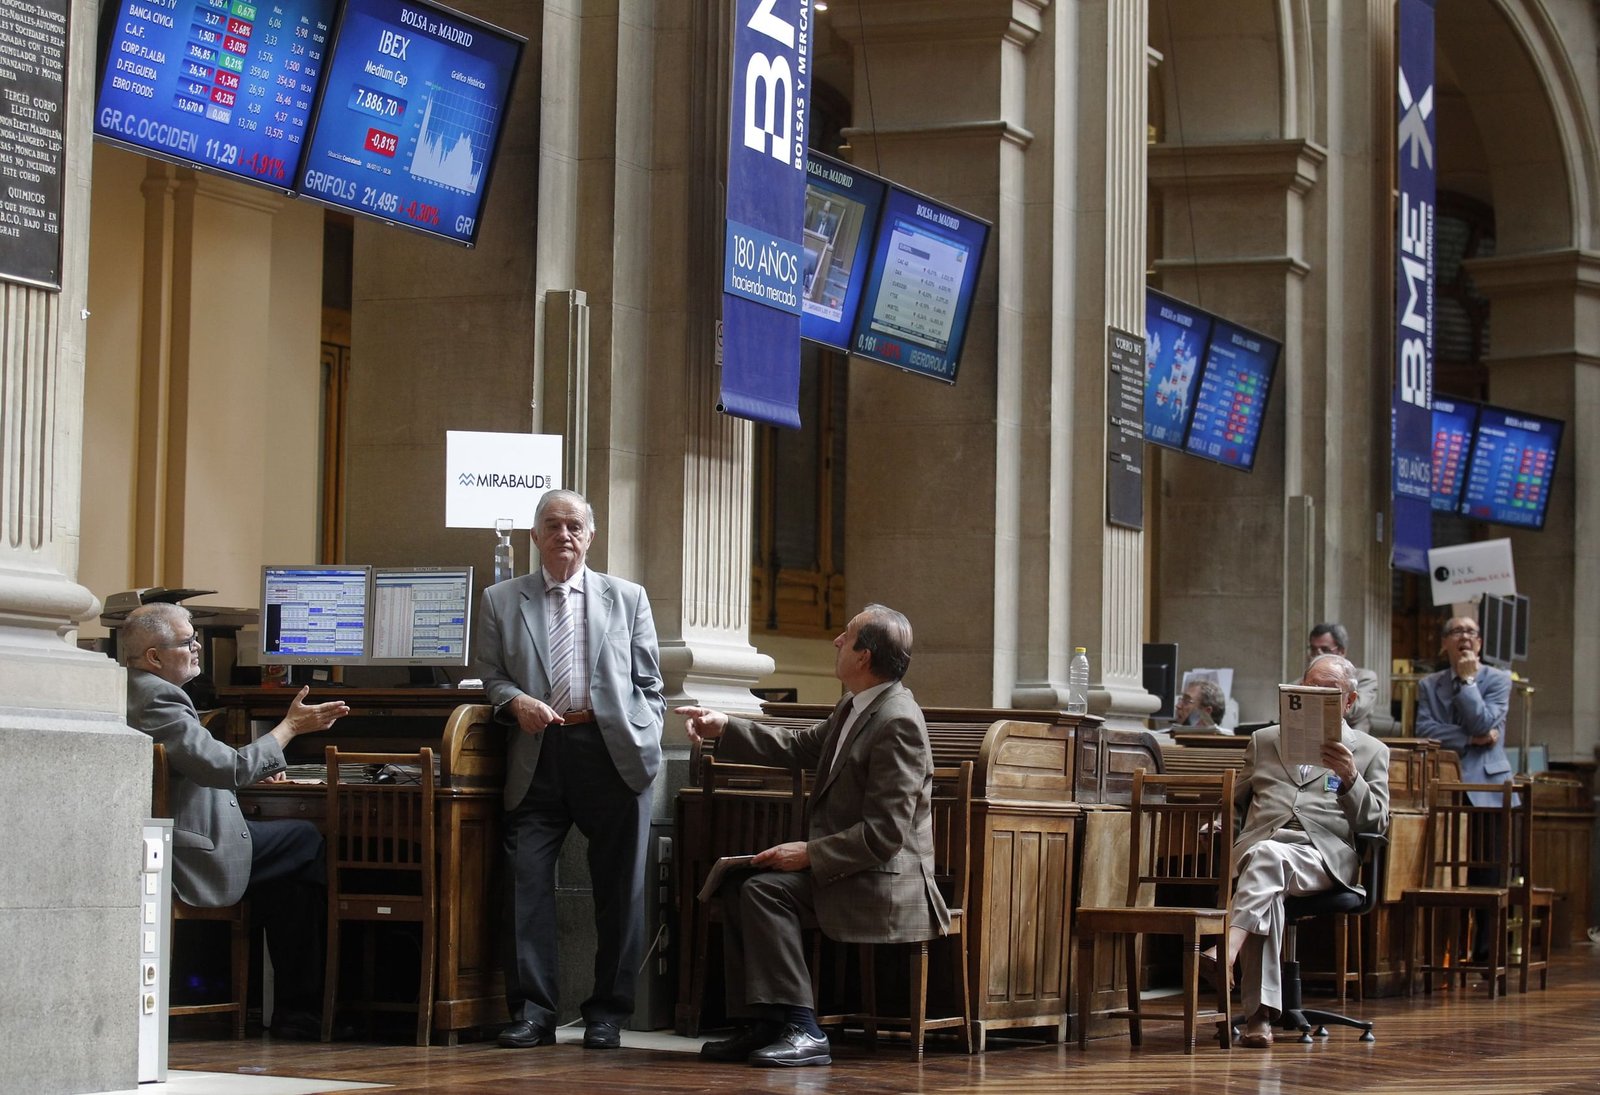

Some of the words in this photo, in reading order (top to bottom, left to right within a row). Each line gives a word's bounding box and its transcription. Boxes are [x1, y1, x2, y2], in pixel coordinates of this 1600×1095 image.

[15, 24, 49, 42] SOCIEDADES
[129, 5, 151, 21] BANCA
[153, 12, 174, 28] CIVICA
[206, 12, 219, 25] 3,27
[232, 23, 251, 37] -2,68%
[400, 9, 427, 31] BOLSA
[438, 23, 473, 48] MADRID
[28, 42, 40, 51] CON
[44, 45, 60, 58] ESTOS
[125, 23, 145, 38] C.A.F.
[198, 30, 215, 42] 1,503
[228, 40, 246, 54] -3,03%
[378, 30, 410, 60] IBEX
[0, 45, 36, 62] CUMULADOR
[121, 40, 166, 64] CORP.FI.ALBA
[190, 45, 211, 60] 356,85
[225, 57, 242, 70] 0,21%
[0, 56, 33, 73] INANZAUTO
[35, 67, 40, 75] Y
[42, 67, 62, 82] MOTOR
[117, 58, 157, 80] D.FELGUERA
[190, 64, 207, 77] 26,54
[219, 75, 238, 88] -1,34%
[364, 60, 393, 80] Medium
[395, 70, 408, 87] Cap
[113, 76, 130, 91] EBRO
[131, 82, 154, 98] FOODS
[188, 83, 202, 94] 4,37
[215, 92, 234, 105] -0,23%
[798, 79, 805, 90] Y
[11, 104, 50, 122] ELECTRICO
[33, 98, 57, 112] CORRO
[178, 98, 198, 112] 13,670
[274, 112, 288, 122] 4,37
[356, 89, 398, 116] 7.886,70
[101, 107, 198, 153] GR.C.OCCIDEN
[206, 139, 237, 164] 11,29
[246, 152, 285, 179] -1,91%
[371, 134, 396, 152] -0,81%
[795, 97, 805, 170] BOLSAS
[15, 144, 50, 162] MONCABRIL
[52, 155, 56, 163] Y
[15, 157, 24, 167] NO
[26, 160, 56, 175] INCLUIDOS
[3, 167, 17, 178] ESTE
[19, 171, 40, 183] CORRO
[806, 160, 822, 177] OLSA
[829, 169, 853, 188] MADRID
[8, 186, 45, 204] QUIMICOS
[305, 170, 356, 200] GRIFOLS
[362, 187, 398, 212] 21,495
[5, 202, 18, 212] QUE
[19, 205, 45, 218] FIGURAN
[49, 211, 56, 220] EN
[917, 204, 933, 220] BOLSA
[938, 213, 960, 230] MADRID
[24, 218, 40, 229] BAJO
[44, 223, 58, 234] ESTE
[733, 235, 754, 270] 180
[758, 241, 798, 285] AÑOS
[732, 268, 765, 297] haciendo
[766, 287, 797, 307] mercado
[1401, 192, 1426, 410] BME
[909, 349, 947, 374] IBERDROLA
[476, 474, 544, 488] MIRABAUD
[1288, 694, 1302, 710] B
